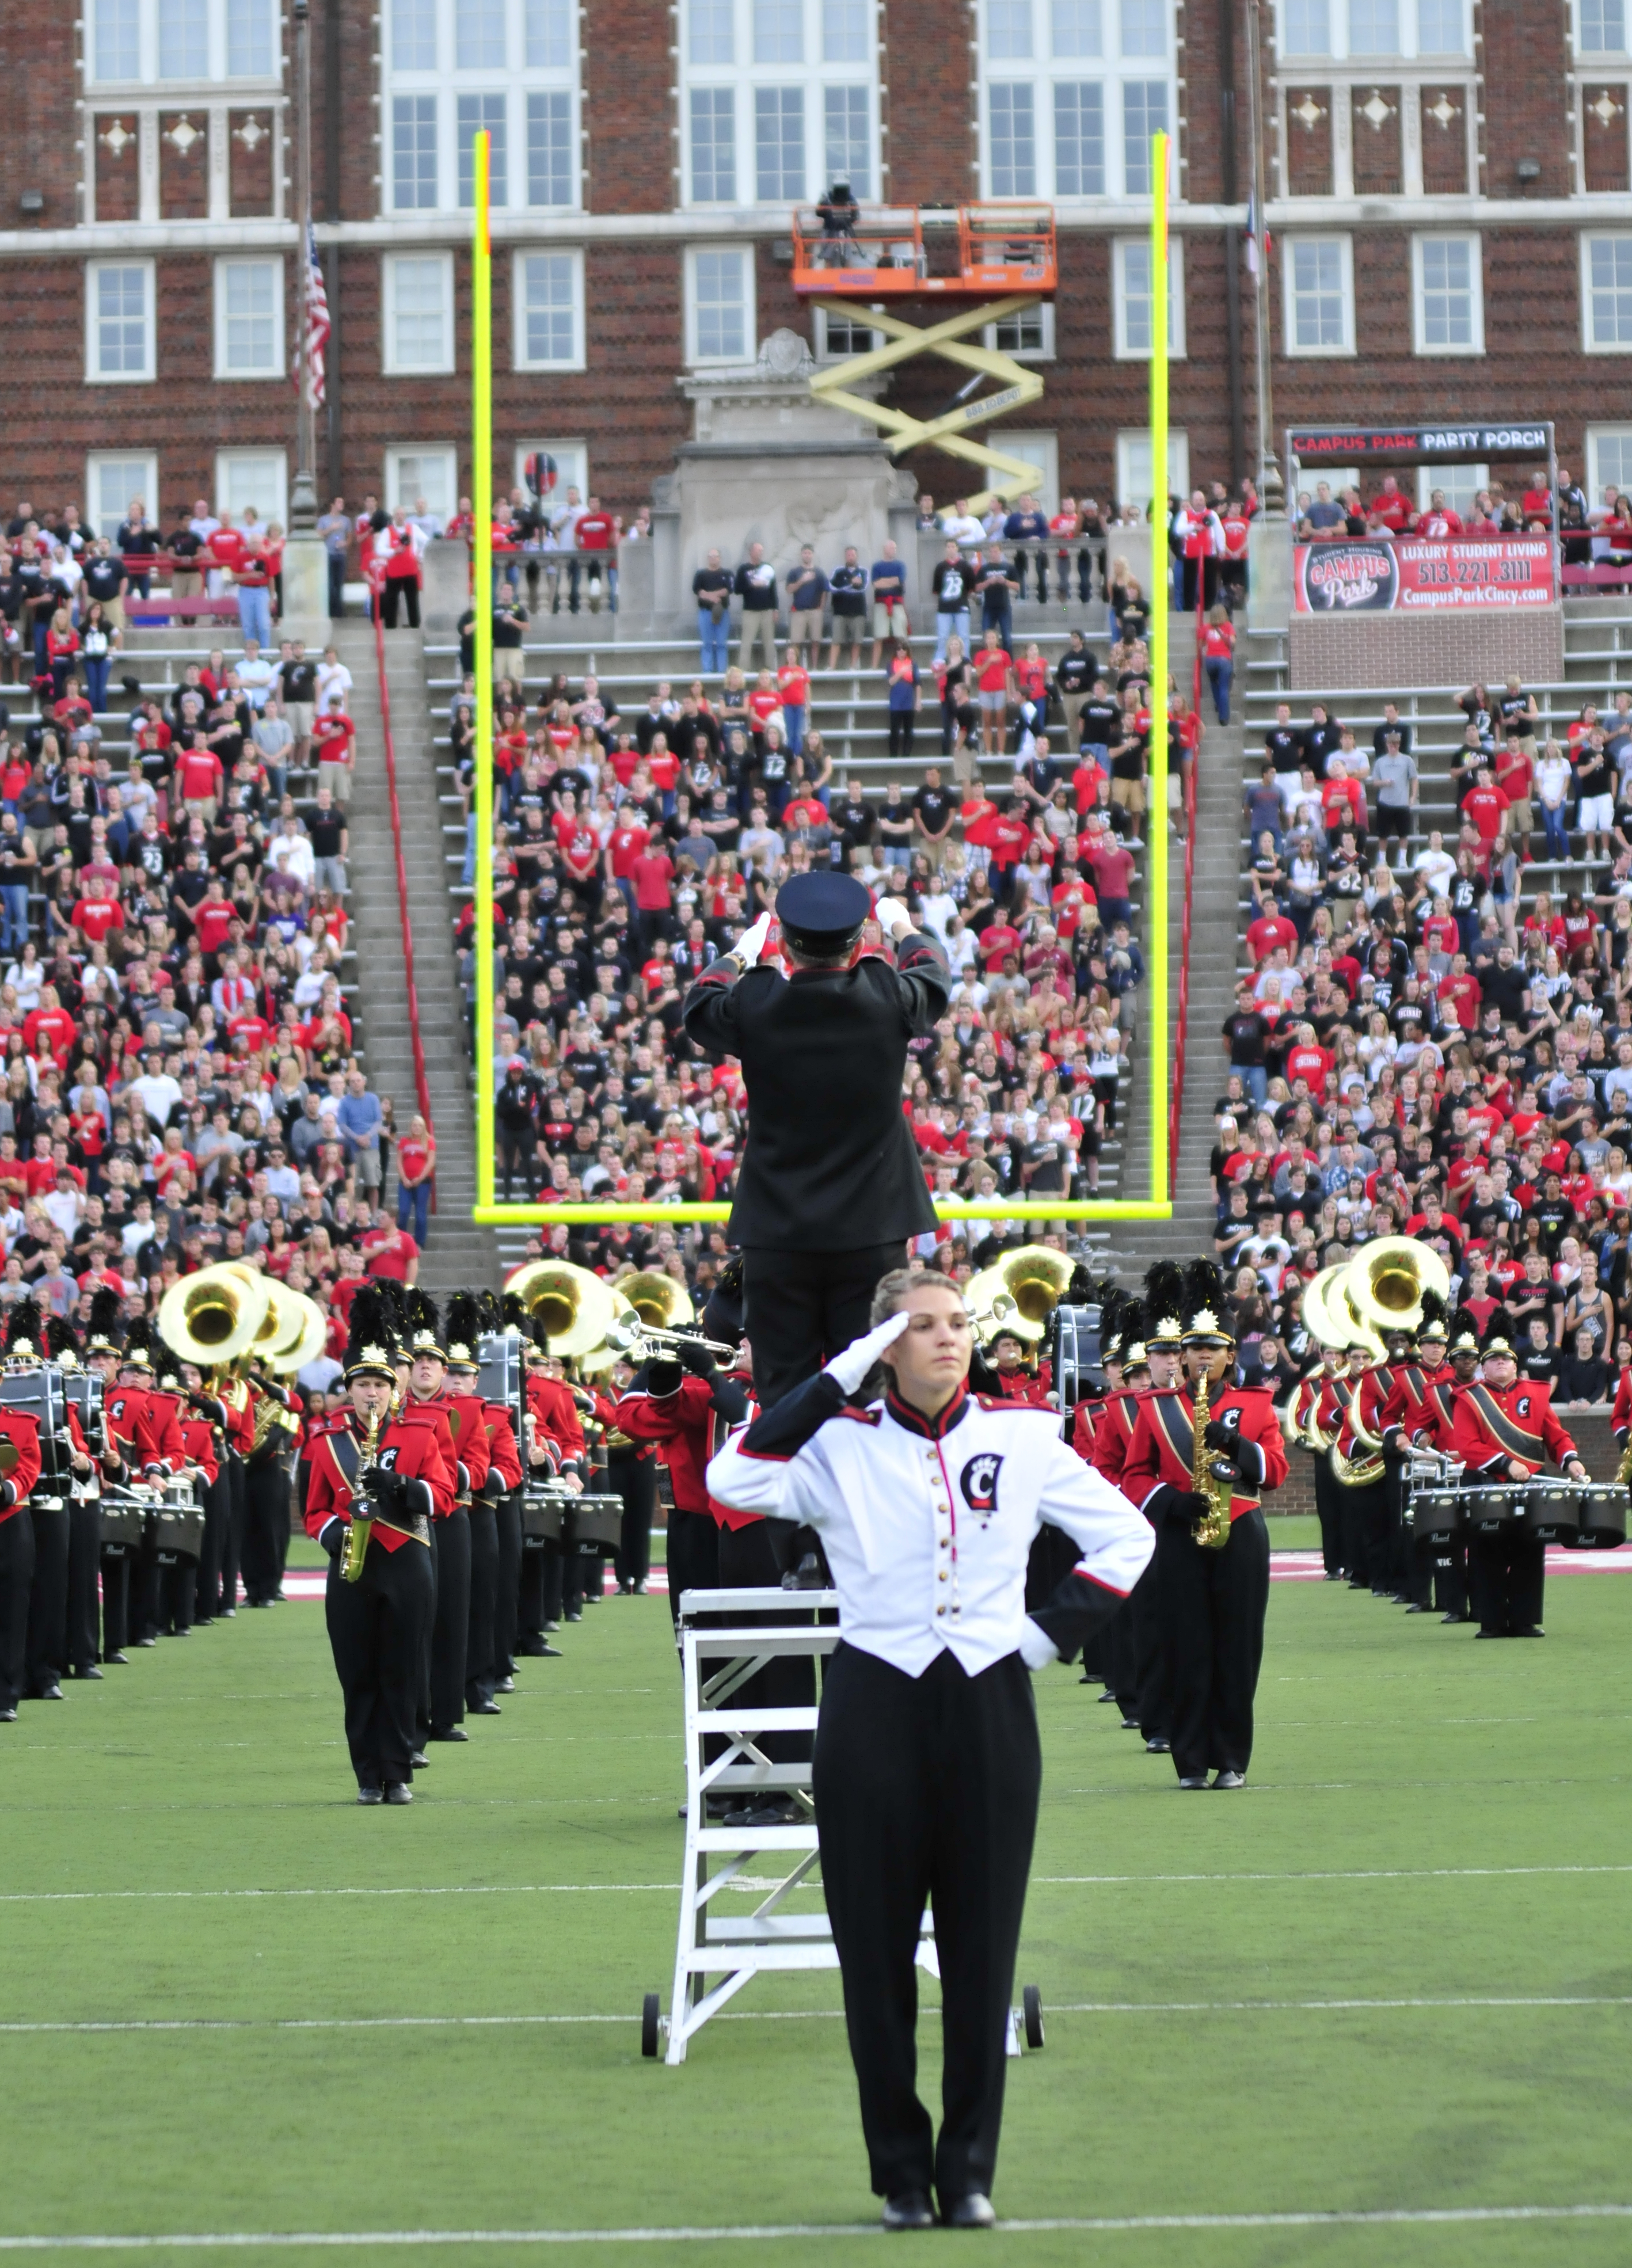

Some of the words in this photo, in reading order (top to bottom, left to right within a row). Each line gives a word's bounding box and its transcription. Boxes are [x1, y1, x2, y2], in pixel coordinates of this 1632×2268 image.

[1294, 435, 1366, 451] CAMPUS
[1372, 435, 1417, 449] PARK
[1424, 432, 1479, 450] PARTY
[1485, 431, 1546, 447] PORCH
[1312, 547, 1345, 564] STUDENT
[1402, 544, 1449, 560] LUXURY
[1452, 543, 1504, 558] STUDENT
[1507, 542, 1548, 557] LIVING
[1310, 553, 1391, 585] CAMPUS
[1418, 560, 1532, 584] 513.221.3111
[1322, 569, 1379, 608] Park
[1403, 585, 1548, 607] CampusParkCincy.com
[766, 759, 787, 775] 12
[1456, 886, 1475, 906] 15
[1074, 1094, 1095, 1120] 12
[1291, 1331, 1309, 1353] 4
[1437, 1557, 1453, 1567] VIC
